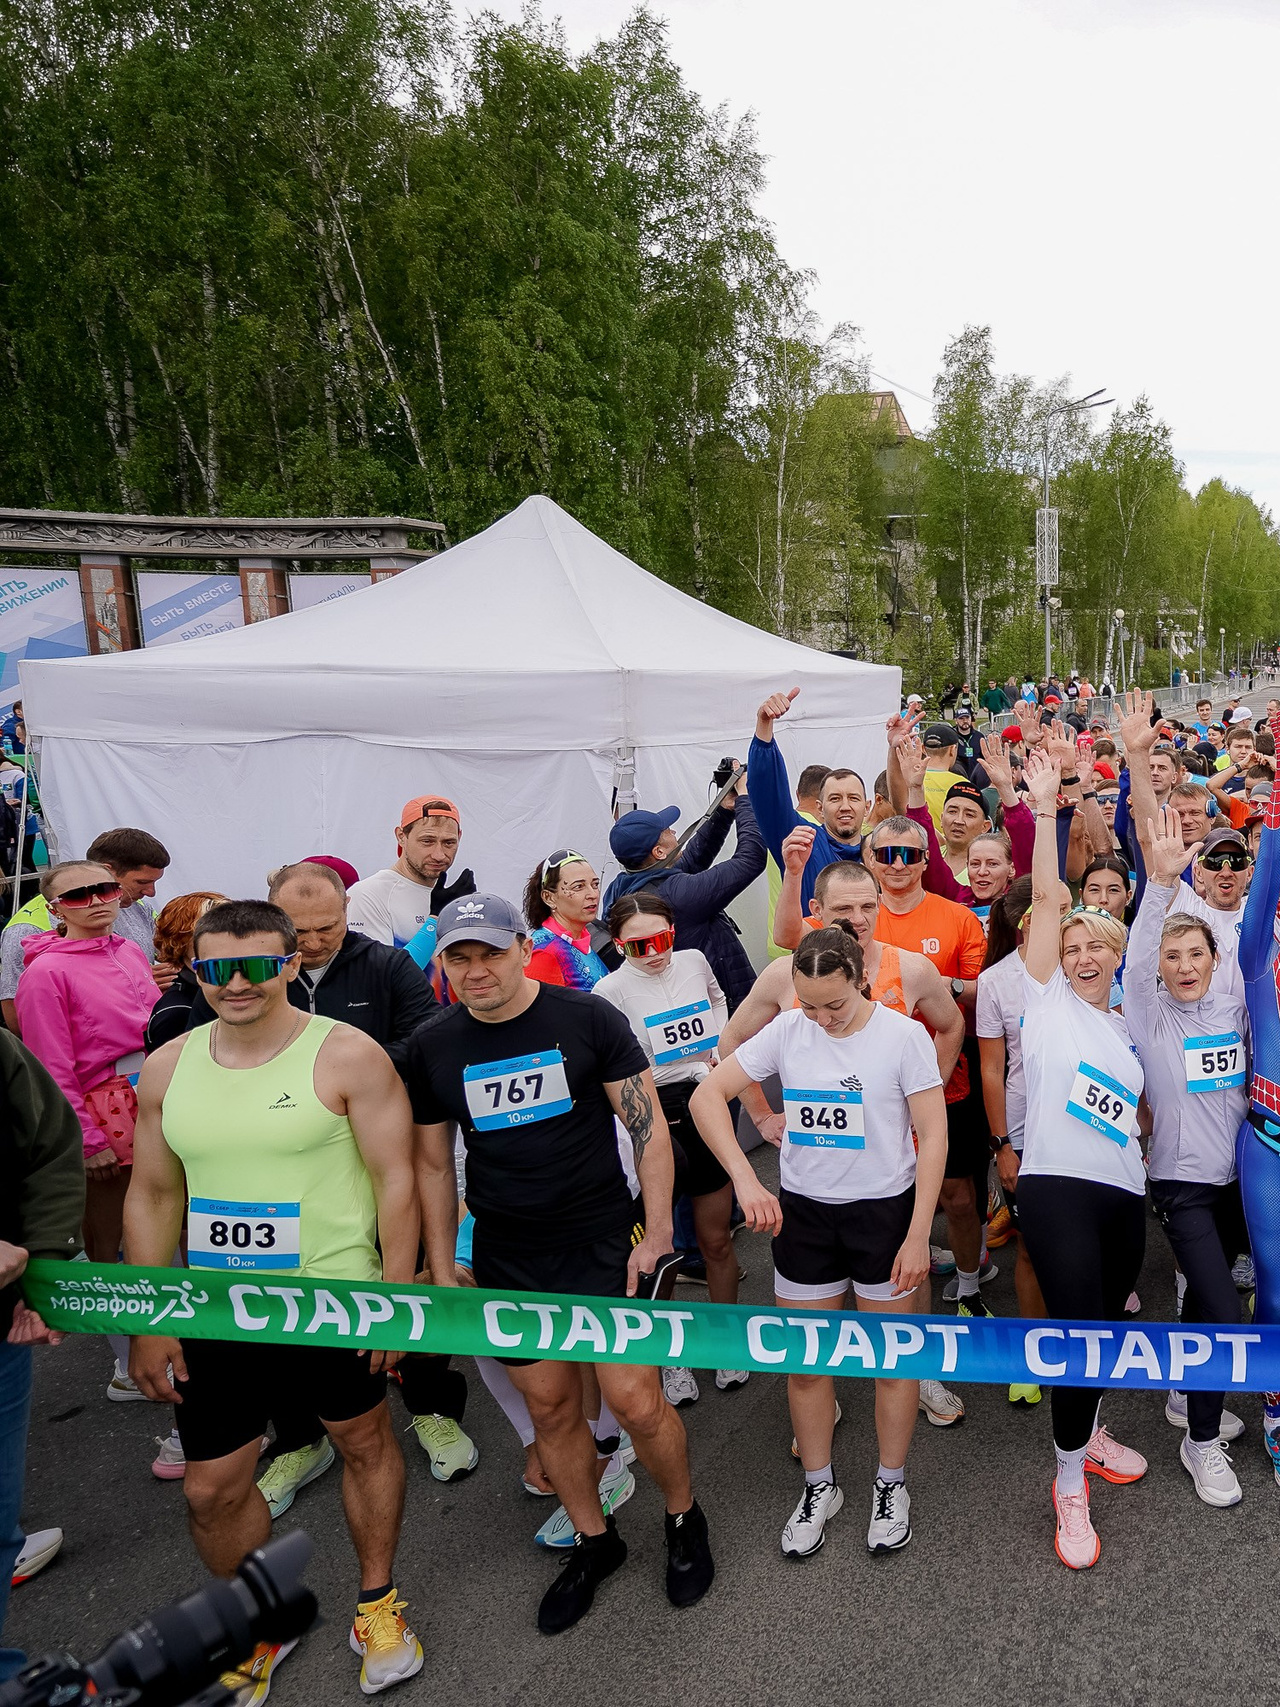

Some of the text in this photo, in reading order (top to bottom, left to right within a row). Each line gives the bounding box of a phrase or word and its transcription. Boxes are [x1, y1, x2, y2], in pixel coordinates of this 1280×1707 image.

[0, 580, 28, 599] ЫТЬ
[0, 577, 70, 616] ВИЖЕНИИ
[150, 582, 233, 627] БЫТЬ ВМЕСТЕ
[180, 621, 213, 640] БЫТЬ
[456, 912, 485, 921] adidas
[921, 937, 940, 955] 10
[663, 1017, 705, 1045] 580
[680, 1047, 690, 1056] 10
[1201, 1048, 1238, 1074] 557
[484, 1073, 544, 1109] 767
[1214, 1079, 1224, 1088] 10
[268, 1102, 299, 1110] DEMIX
[1085, 1083, 1123, 1121] 569
[507, 1112, 521, 1124] 10
[800, 1106, 848, 1130] 848
[1090, 1116, 1099, 1127] 10
[814, 1136, 825, 1145] 10
[209, 1220, 276, 1249] 803
[226, 1256, 241, 1267] 10
[55, 1277, 158, 1297] зелёный
[50, 1295, 155, 1319] марафон
[228, 1284, 432, 1341] СТАРТ
[483, 1300, 694, 1358] СТАРТ
[746, 1315, 970, 1373] СТАРТ
[1024, 1327, 1261, 1383] СТАРТ
